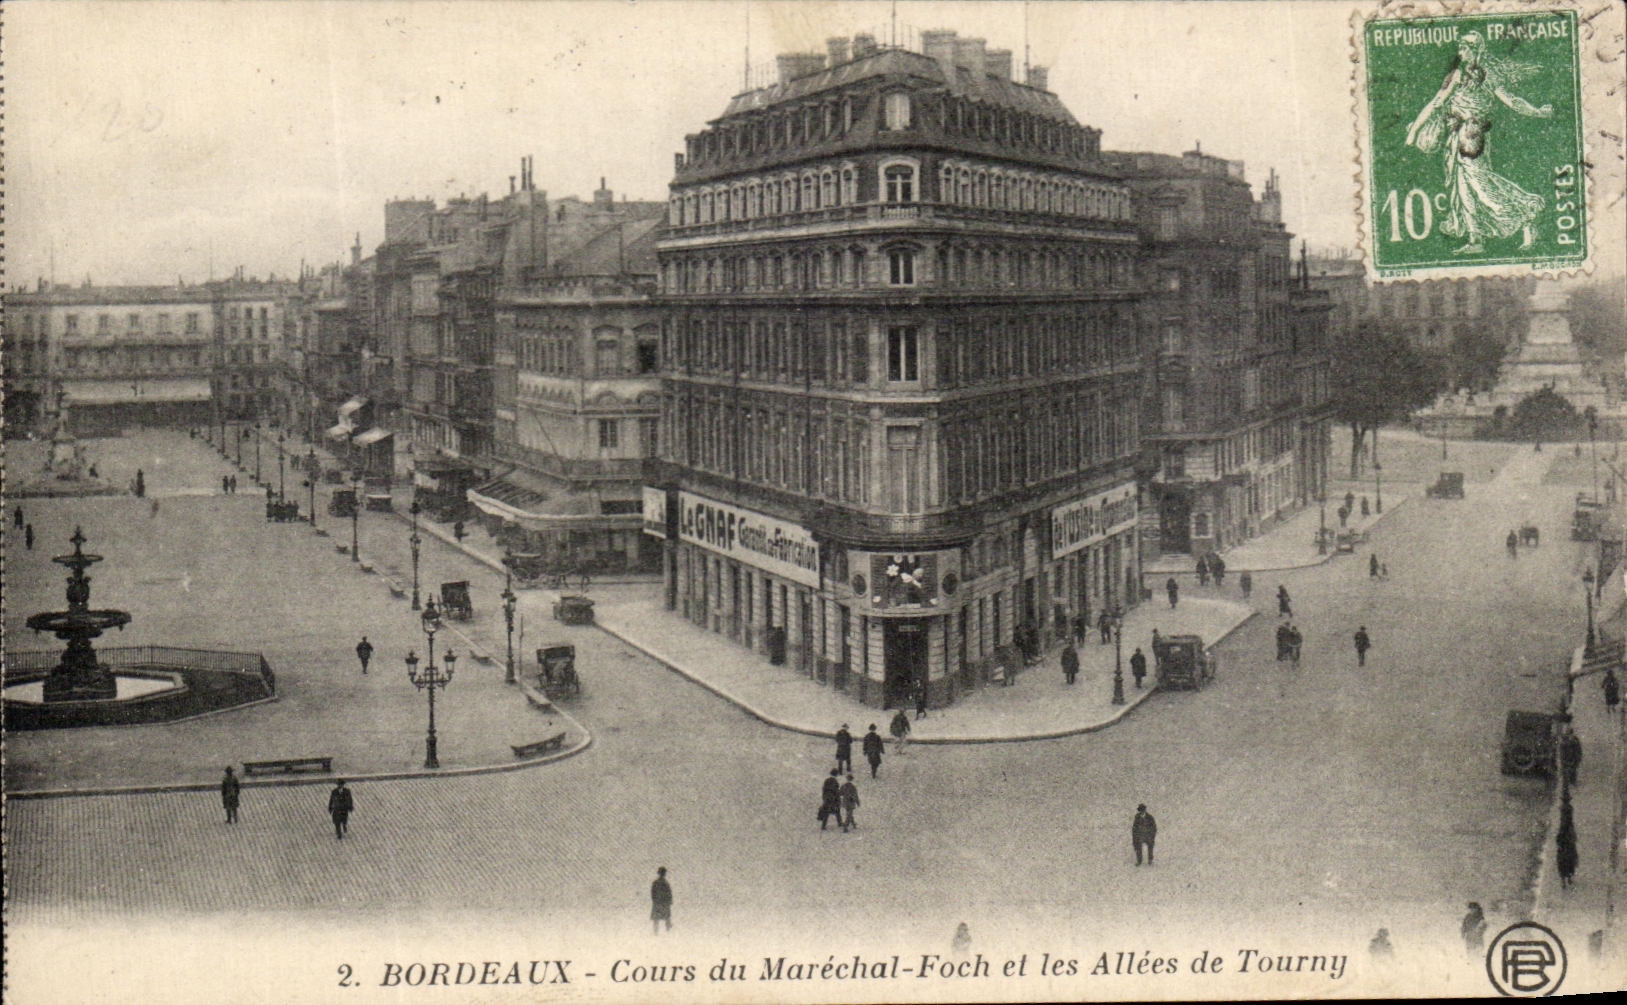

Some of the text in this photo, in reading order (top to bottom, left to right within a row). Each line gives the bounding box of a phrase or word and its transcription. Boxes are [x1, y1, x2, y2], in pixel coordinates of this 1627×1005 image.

[1373, 20, 1569, 47] REPUBLIQUE FRANÇAISE
[1554, 164, 1577, 246] POSTES
